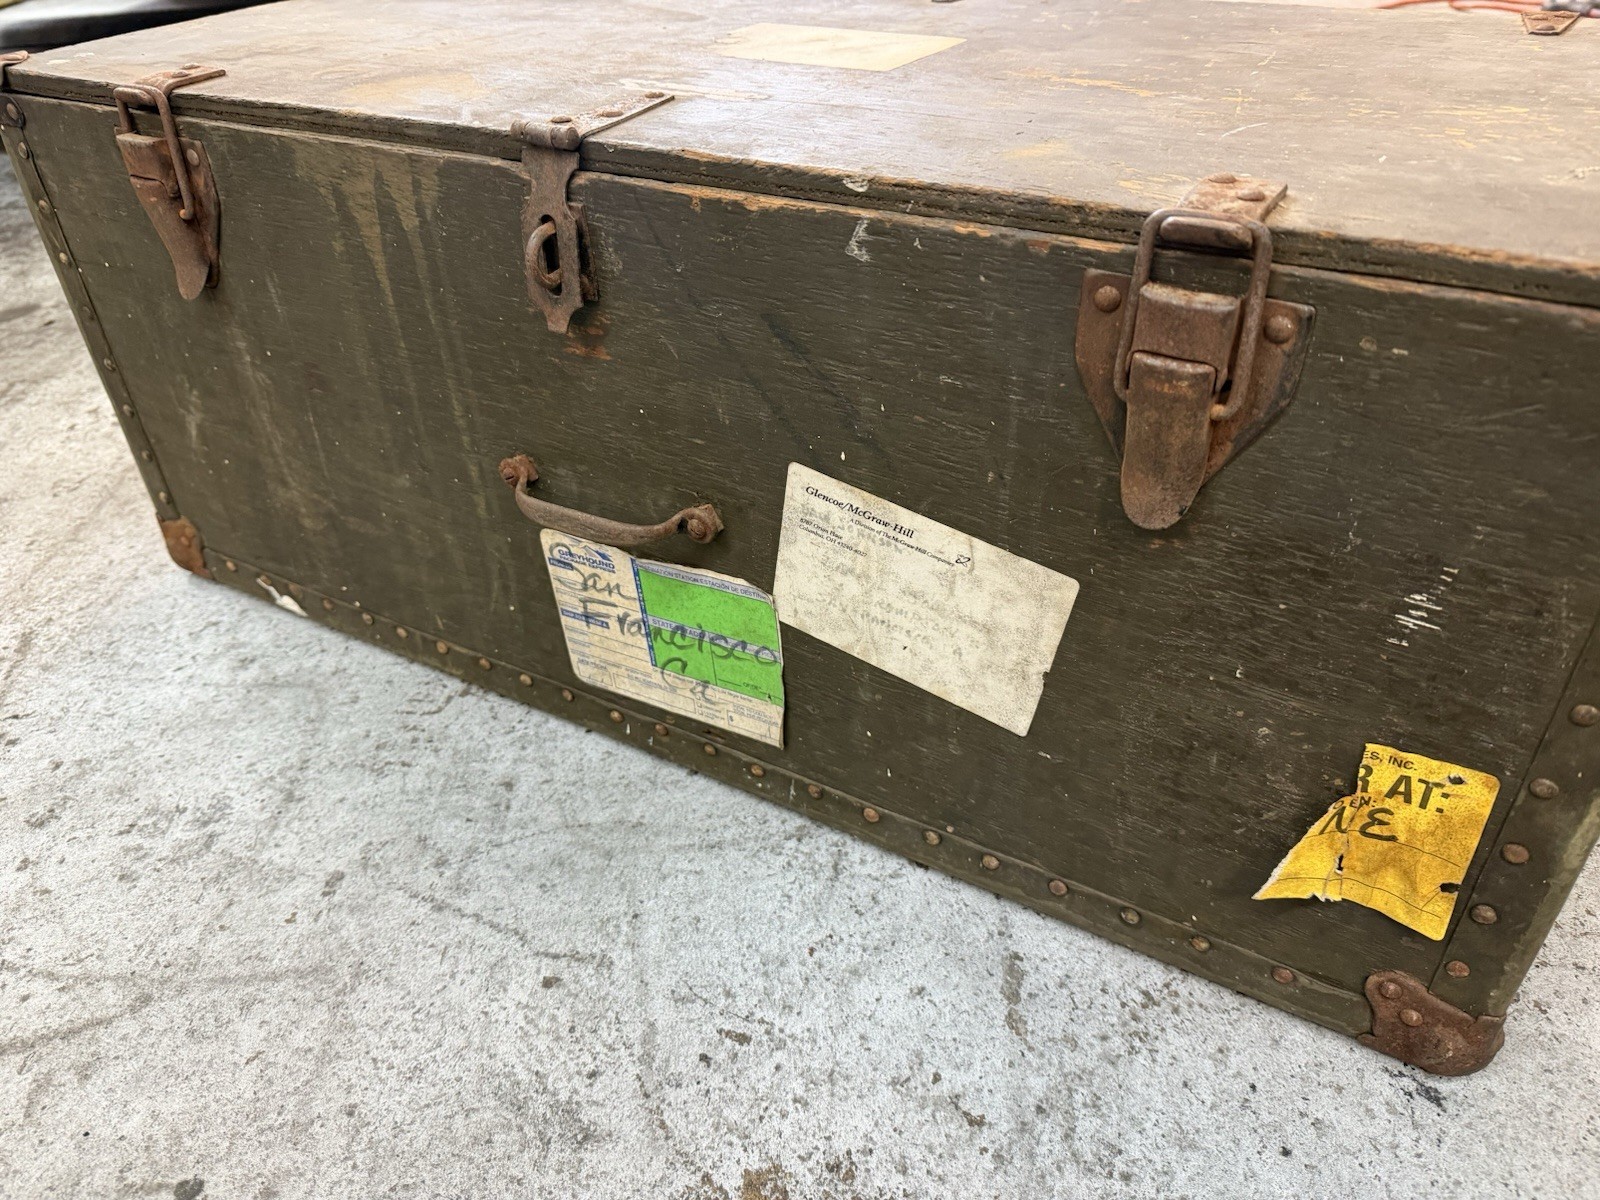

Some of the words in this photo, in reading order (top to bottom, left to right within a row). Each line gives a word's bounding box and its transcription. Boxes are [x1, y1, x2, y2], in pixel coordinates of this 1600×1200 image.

[805, 486, 915, 539] Glencoe/McGraw-Hill
[825, 536, 837, 544] OH
[855, 520, 876, 532] Division
[882, 532, 892, 541] The
[892, 536, 928, 555] McGraw-Hill
[549, 542, 637, 601] San
[558, 549, 615, 570] GREYHOUND
[578, 597, 778, 666] Francisco
[1388, 755, 1418, 771] INC.
[1383, 774, 1451, 814] AT:
